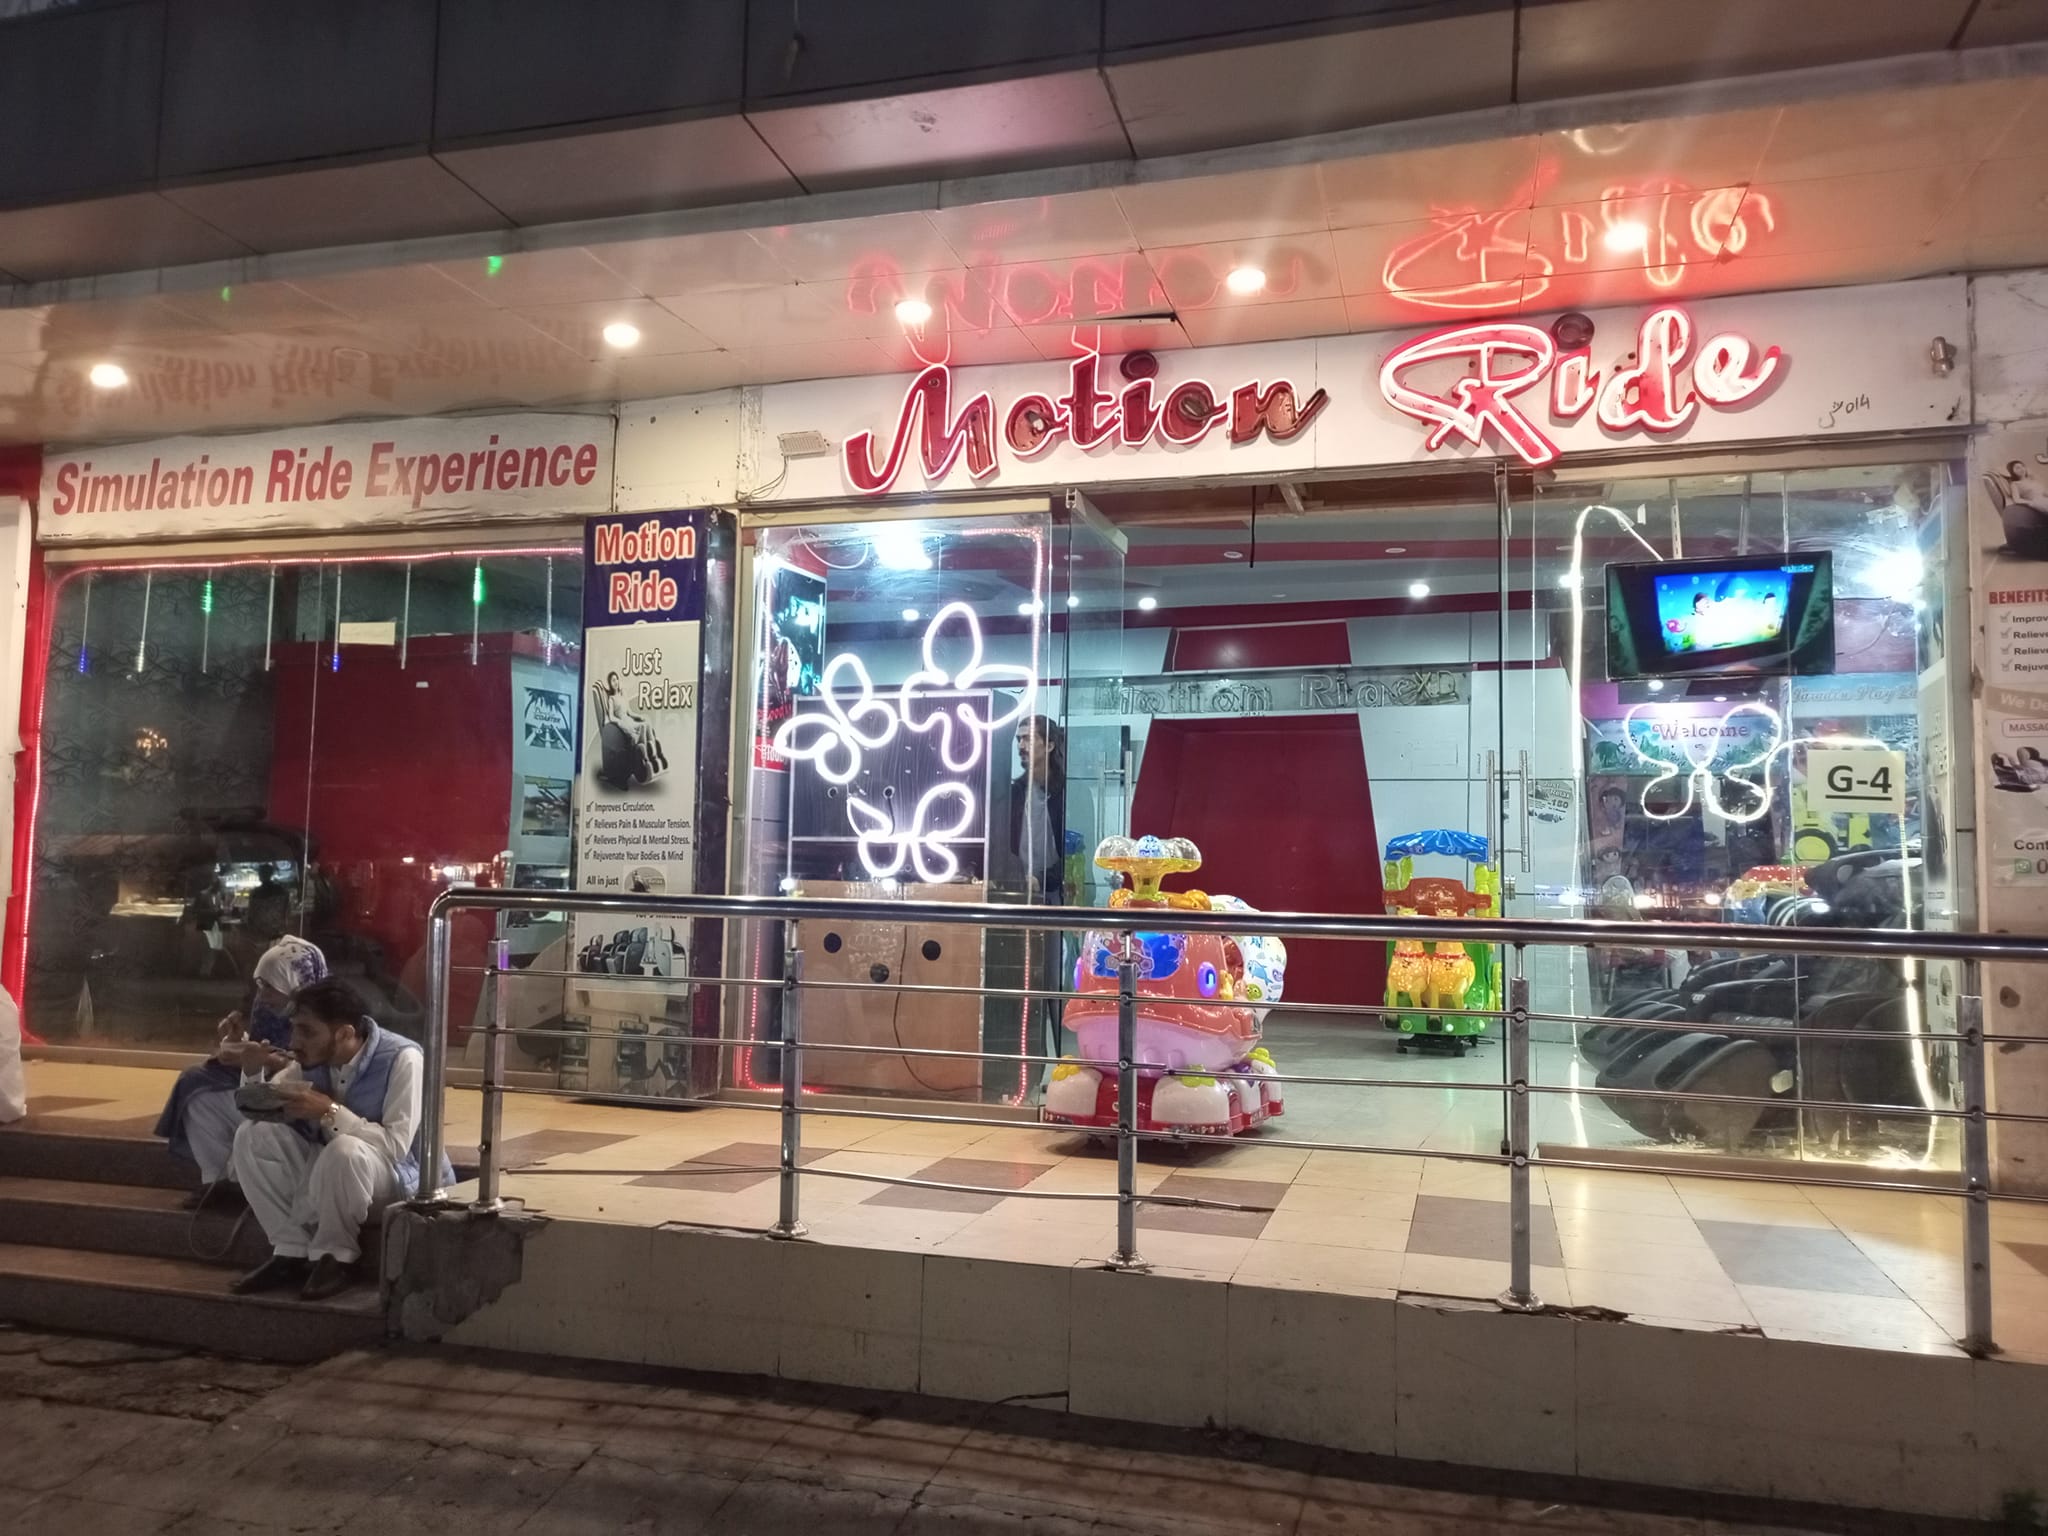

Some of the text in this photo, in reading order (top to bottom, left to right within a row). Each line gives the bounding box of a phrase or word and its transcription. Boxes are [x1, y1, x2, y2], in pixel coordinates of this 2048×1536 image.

[843, 306, 1783, 494] Motion Ride
[52, 434, 598, 516] Simulation Ride Experience
[595, 520, 696, 565] Motion
[609, 570, 678, 614] Ride
[622, 647, 662, 677] Just
[639, 678, 693, 710] Relax
[1652, 720, 1750, 740] Welcome
[1827, 765, 1893, 794] G-4
[595, 802, 655, 813] Improves Circulation.
[594, 819, 691, 829] Relieves Pain & Muscular Tension.
[594, 835, 690, 846] Relieves Physical & Mental Stress.
[593, 851, 684, 862] Rejuvenate Your Bodies & Mind
[586, 876, 619, 888] All in just
